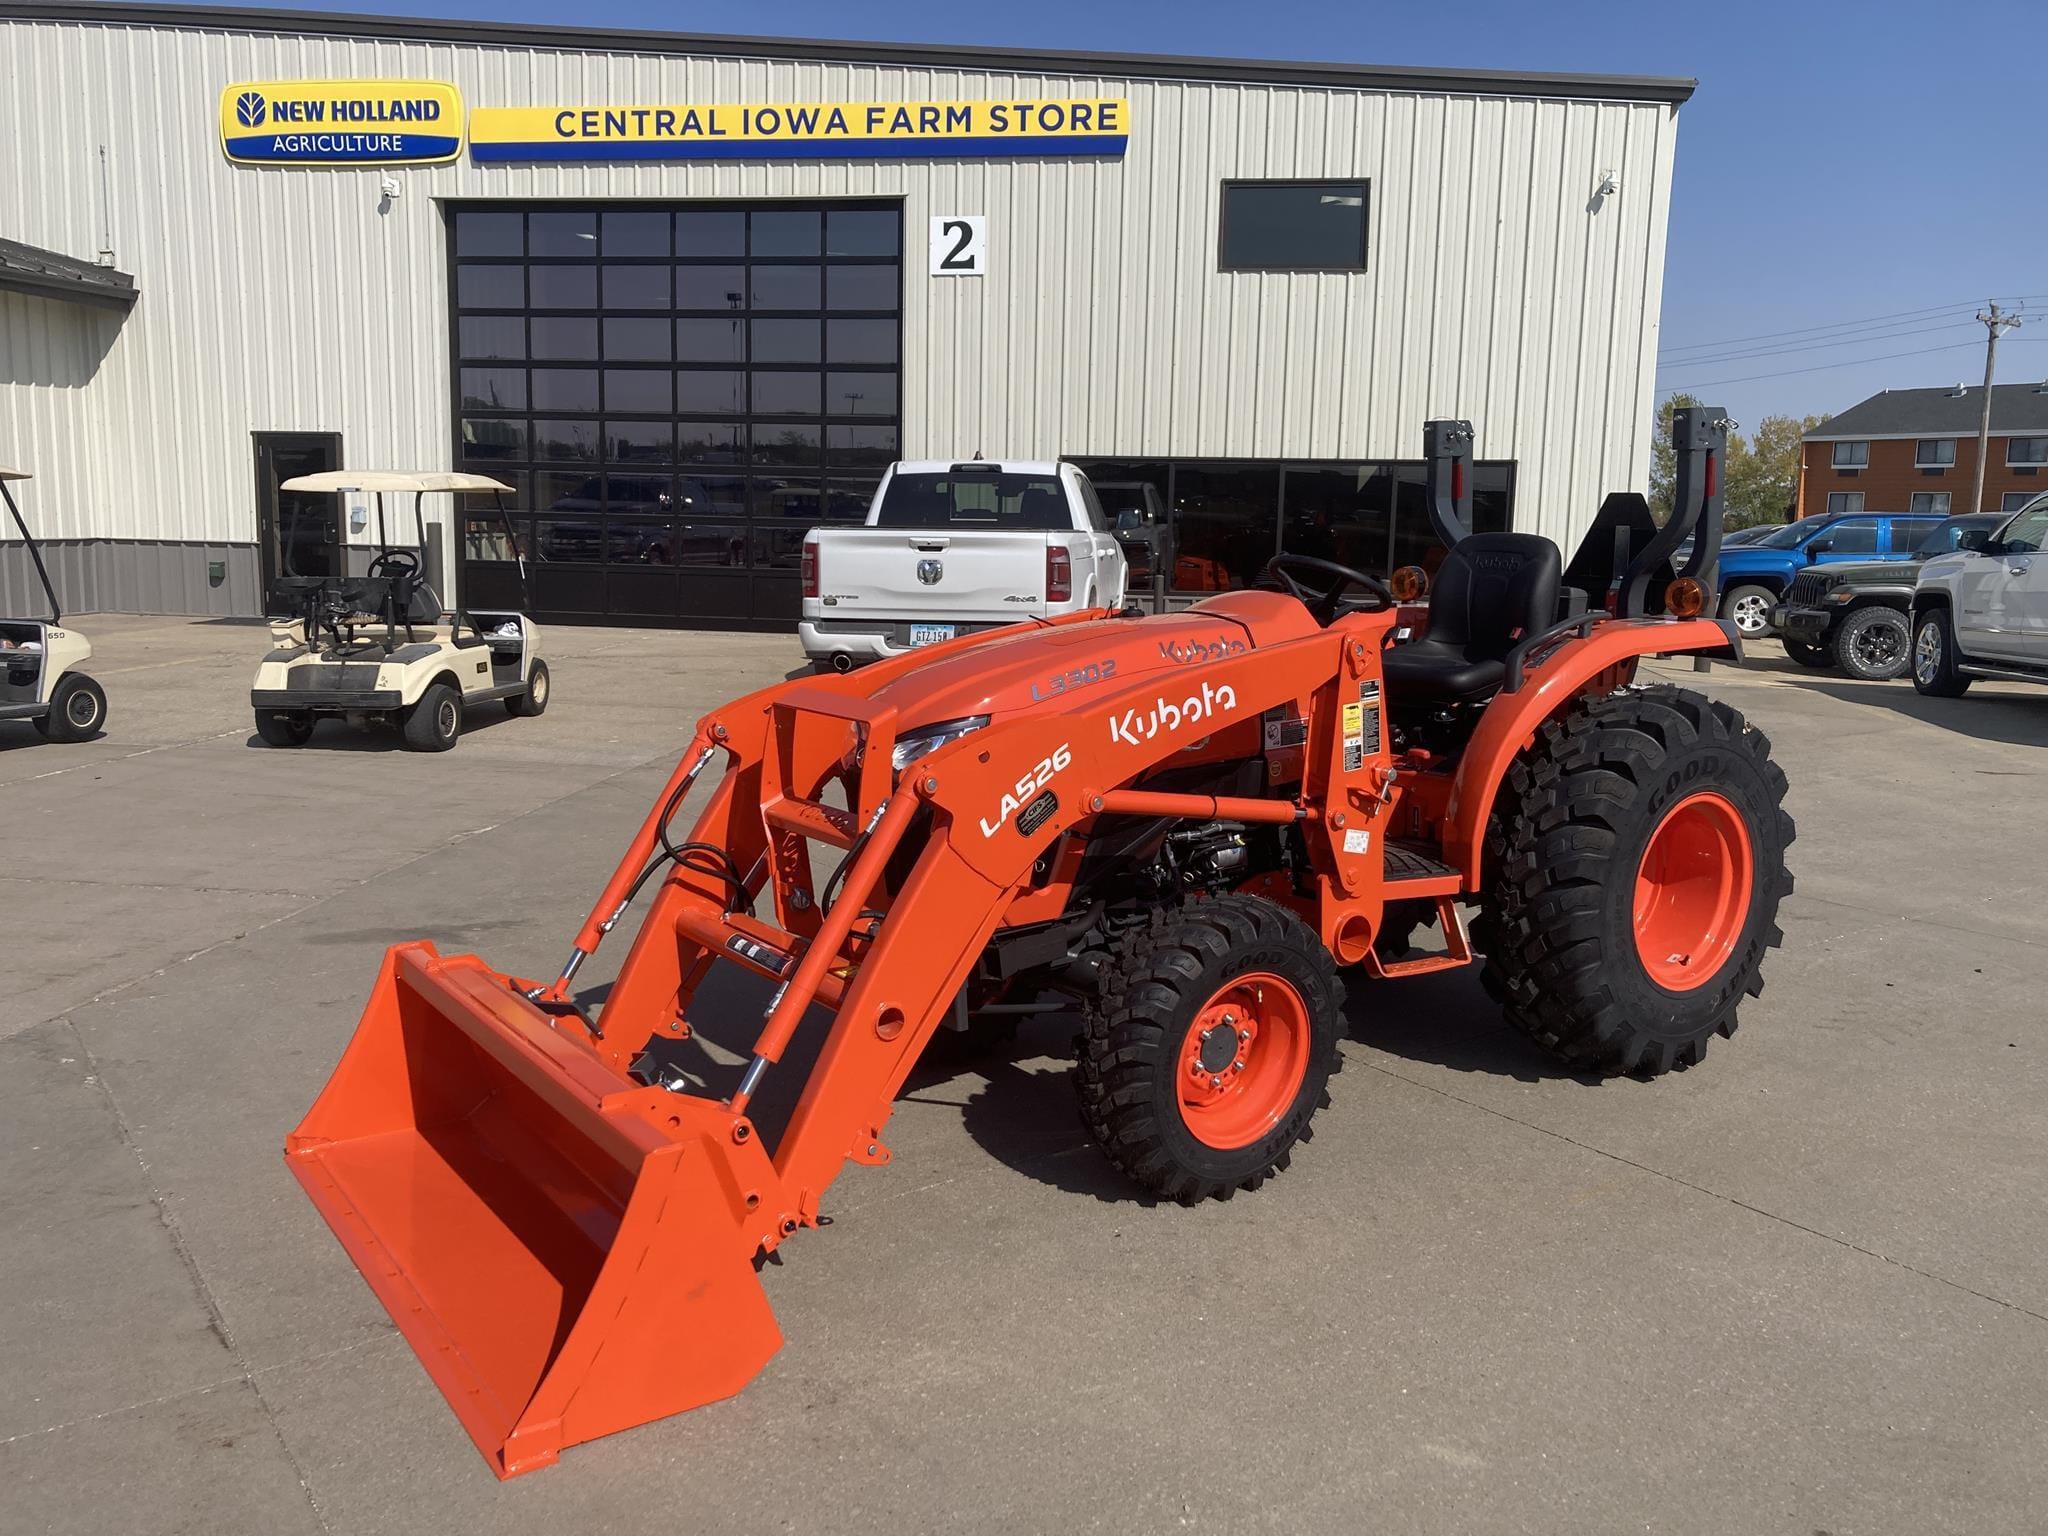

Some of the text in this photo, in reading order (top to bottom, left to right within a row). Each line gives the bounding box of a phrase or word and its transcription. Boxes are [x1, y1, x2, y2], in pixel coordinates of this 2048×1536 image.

[272, 99, 440, 122] NEW HOLLAND
[554, 103, 1118, 138] CENTRAL IOWA FARM STORE
[273, 134, 402, 153] AGRICULTURE
[940, 220, 975, 270] 2
[1158, 635, 1248, 664] Kubota
[1030, 659, 1117, 702] L3302
[1109, 681, 1237, 746] Kubota
[978, 742, 1073, 839] LA526
